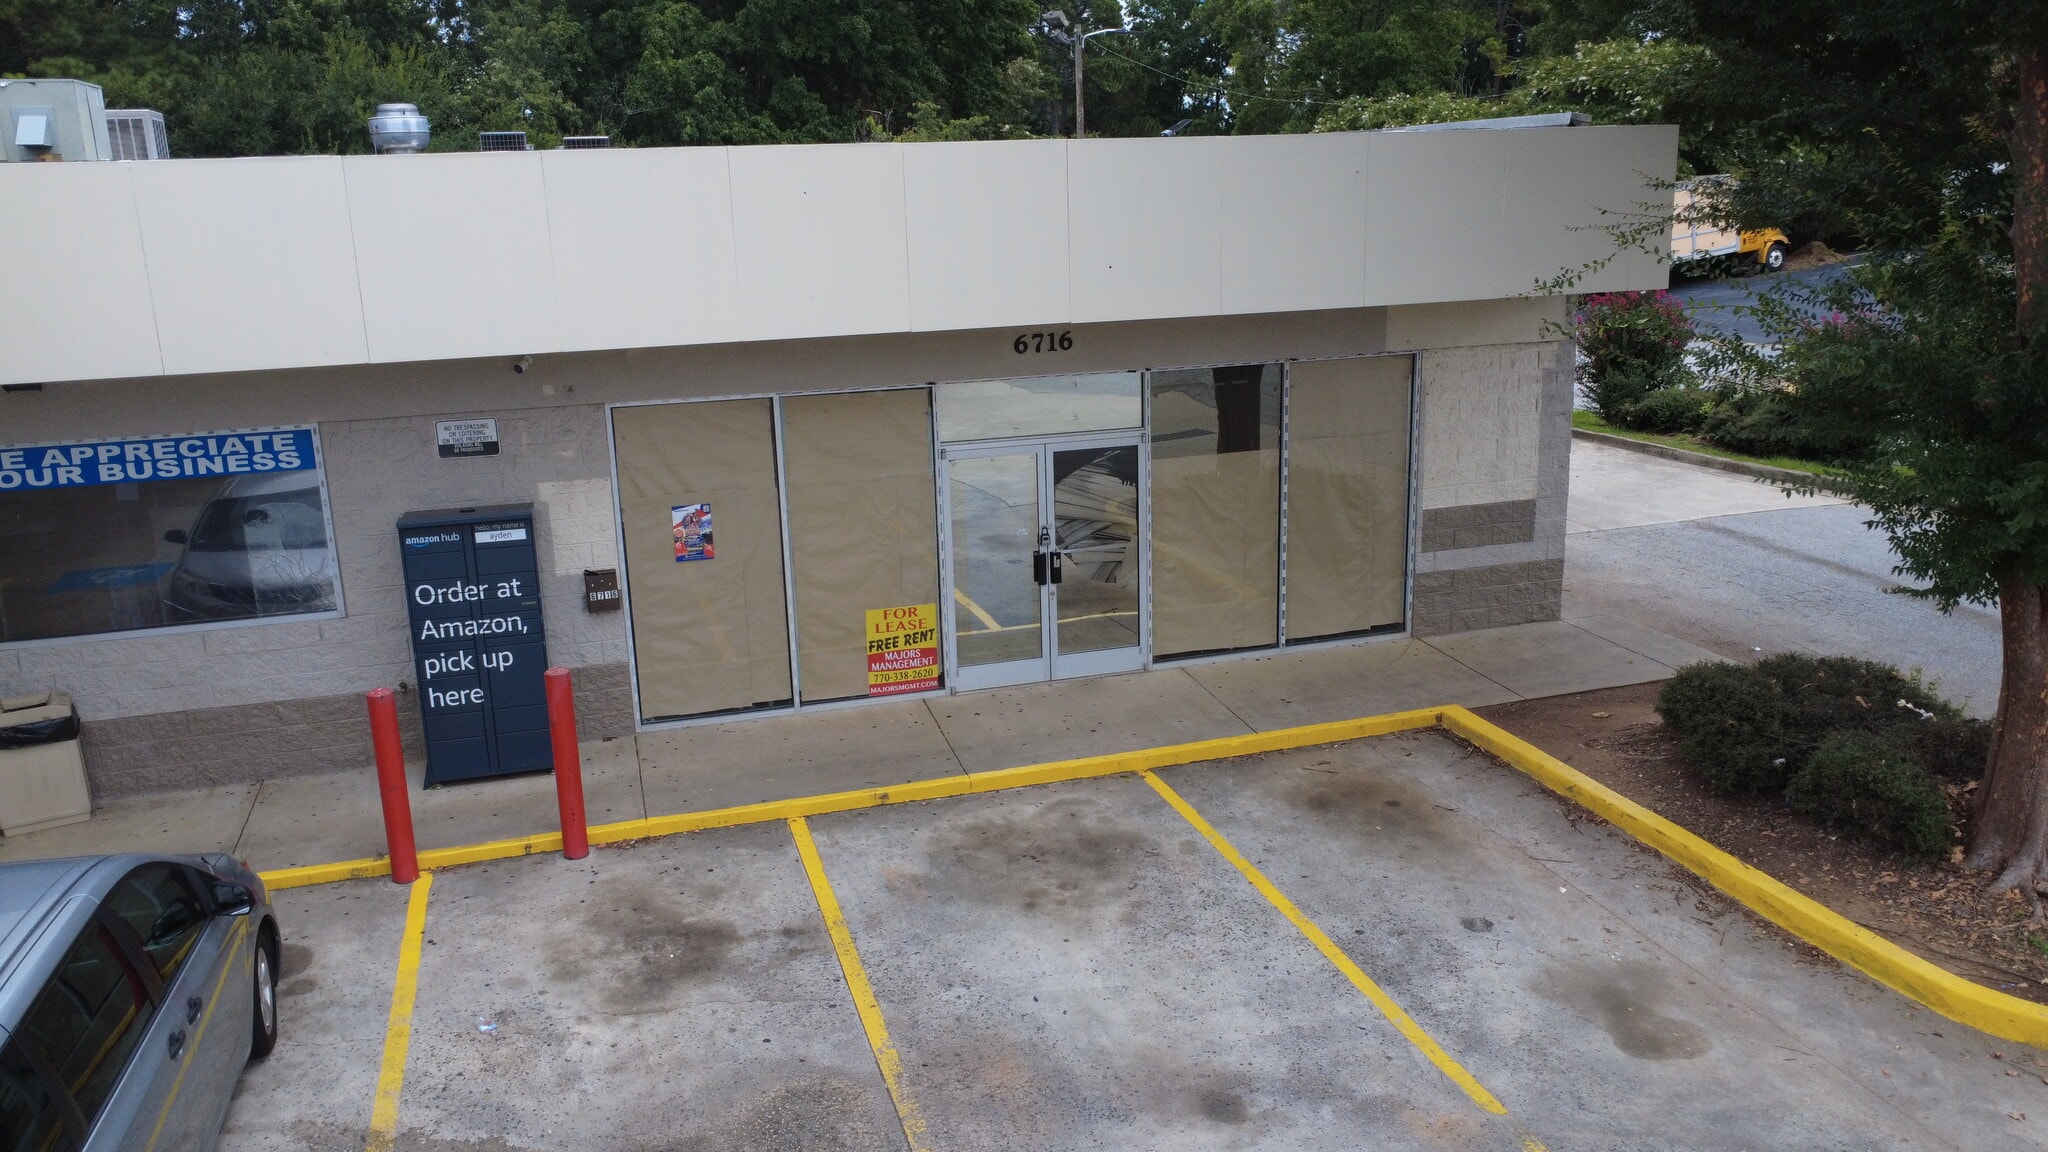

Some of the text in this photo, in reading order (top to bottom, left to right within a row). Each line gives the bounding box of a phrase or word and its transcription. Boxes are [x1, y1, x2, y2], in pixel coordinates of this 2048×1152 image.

[1013, 330, 1073, 354] 6716
[454, 423, 489, 431] TRESPASSING
[458, 429, 485, 437] LOITERING
[41, 433, 296, 467] APPRECIATE
[98, 451, 301, 482] BUSINESS
[405, 532, 460, 545] amazon hub
[489, 531, 512, 542] ayden
[415, 578, 522, 605] Order at
[590, 590, 618, 601] 6716
[883, 607, 918, 620] FOR
[421, 615, 528, 640] Amazon,
[875, 618, 927, 633] LEASE
[868, 629, 935, 652] FREE RENT
[884, 649, 921, 661] MAJORS
[424, 650, 514, 679] pick up
[871, 656, 934, 671] MANAGEMENT
[873, 668, 934, 683] 770-338-2620
[870, 681, 938, 693] MAJORSMGMT.COM
[428, 687, 484, 708] here
